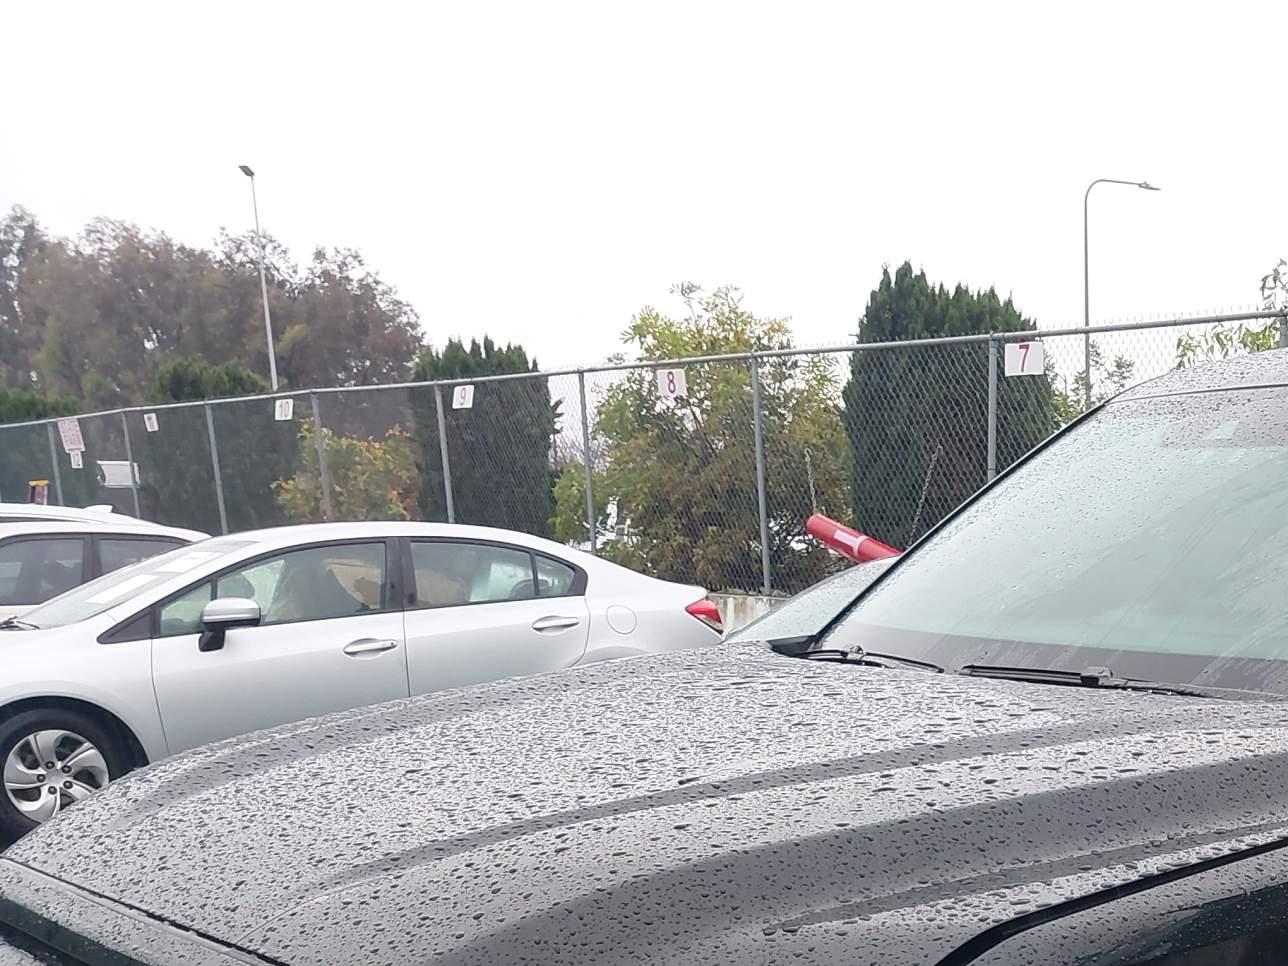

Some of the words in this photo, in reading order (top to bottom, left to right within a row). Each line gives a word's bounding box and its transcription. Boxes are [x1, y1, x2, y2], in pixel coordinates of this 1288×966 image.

[1018, 344, 1031, 373] 7
[667, 371, 676, 394] 8
[460, 387, 467, 406] 9
[278, 400, 290, 418] 10
